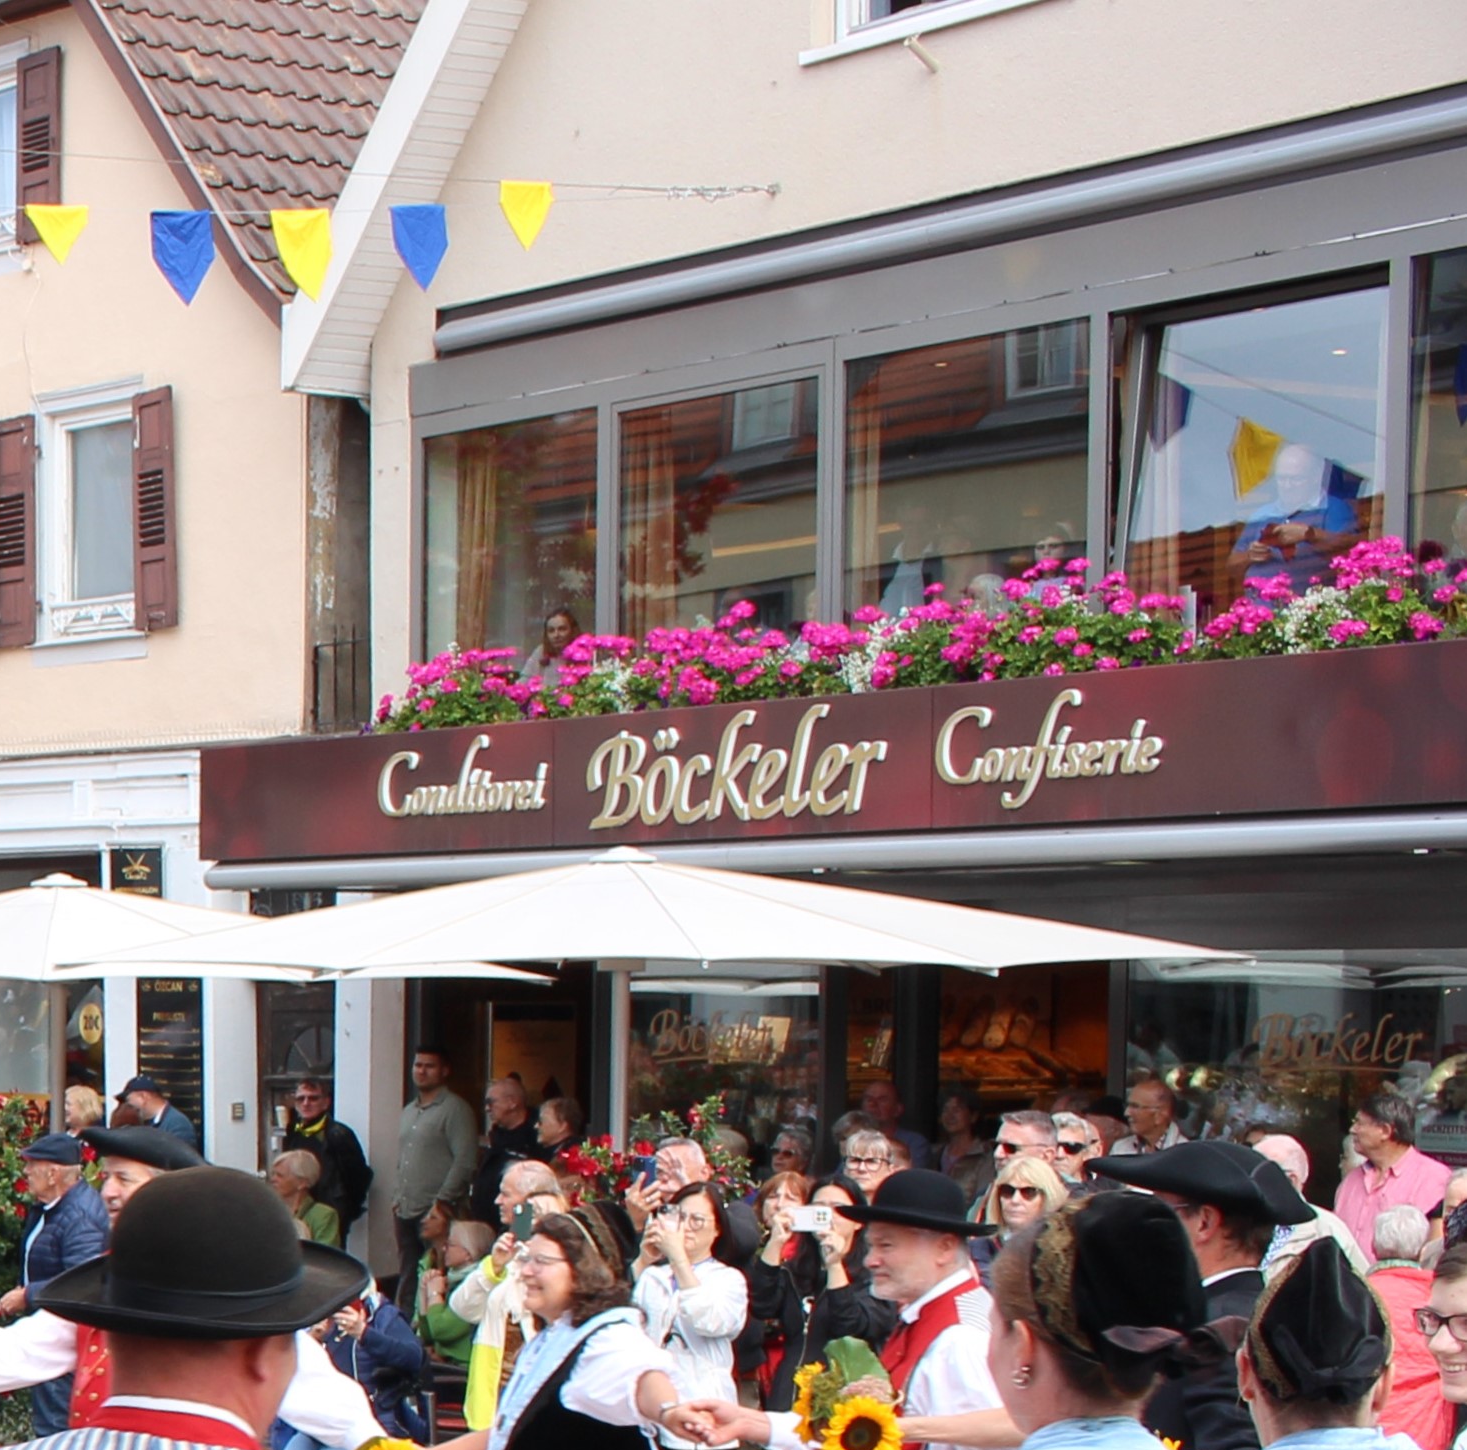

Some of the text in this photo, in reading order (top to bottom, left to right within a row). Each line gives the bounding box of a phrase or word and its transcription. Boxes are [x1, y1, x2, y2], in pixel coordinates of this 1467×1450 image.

[377, 688, 1164, 830] Conditorei Böckeler Confiserie
[1252, 1012, 1424, 1066] Böckeler
